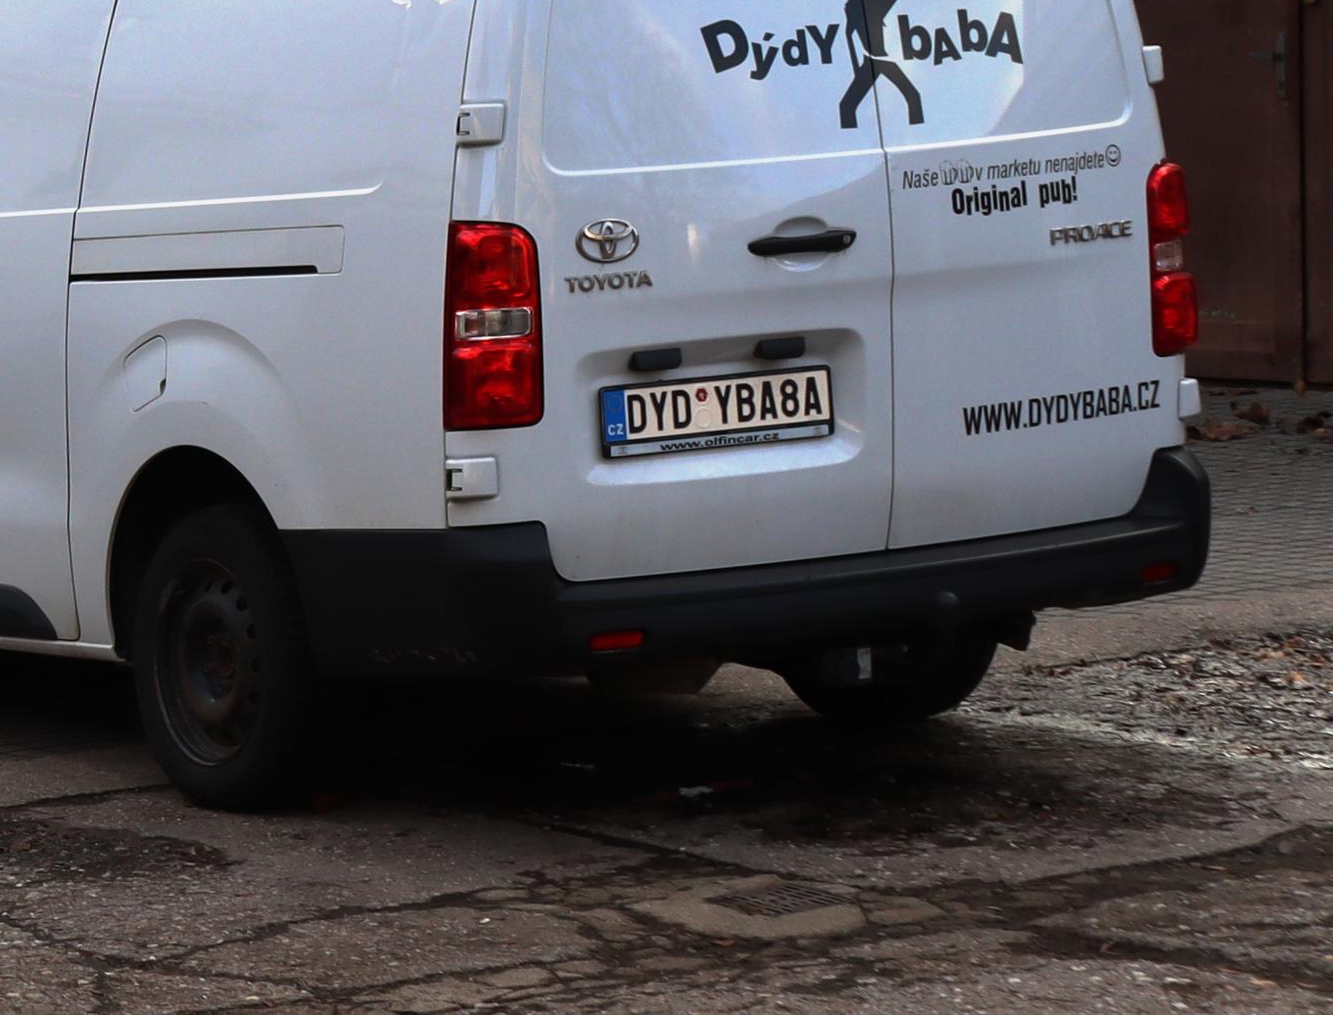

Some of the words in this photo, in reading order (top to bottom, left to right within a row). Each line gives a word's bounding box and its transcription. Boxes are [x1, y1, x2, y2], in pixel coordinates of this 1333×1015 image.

[902, 169, 938, 189] Naše
[987, 159, 1041, 180] marketu
[1045, 151, 1105, 175] nenajdete
[951, 180, 1027, 216] Original
[1039, 176, 1077, 208] pub!
[1050, 220, 1133, 246] PROACE
[565, 270, 652, 294] TOYOTA
[627, 390, 692, 434] DYD
[714, 377, 822, 425] YBA8A
[963, 380, 1160, 435] WWW.DYDYBABA.CZ
[608, 424, 624, 436] CZ
[661, 431, 780, 452] www.olfincar.cz
